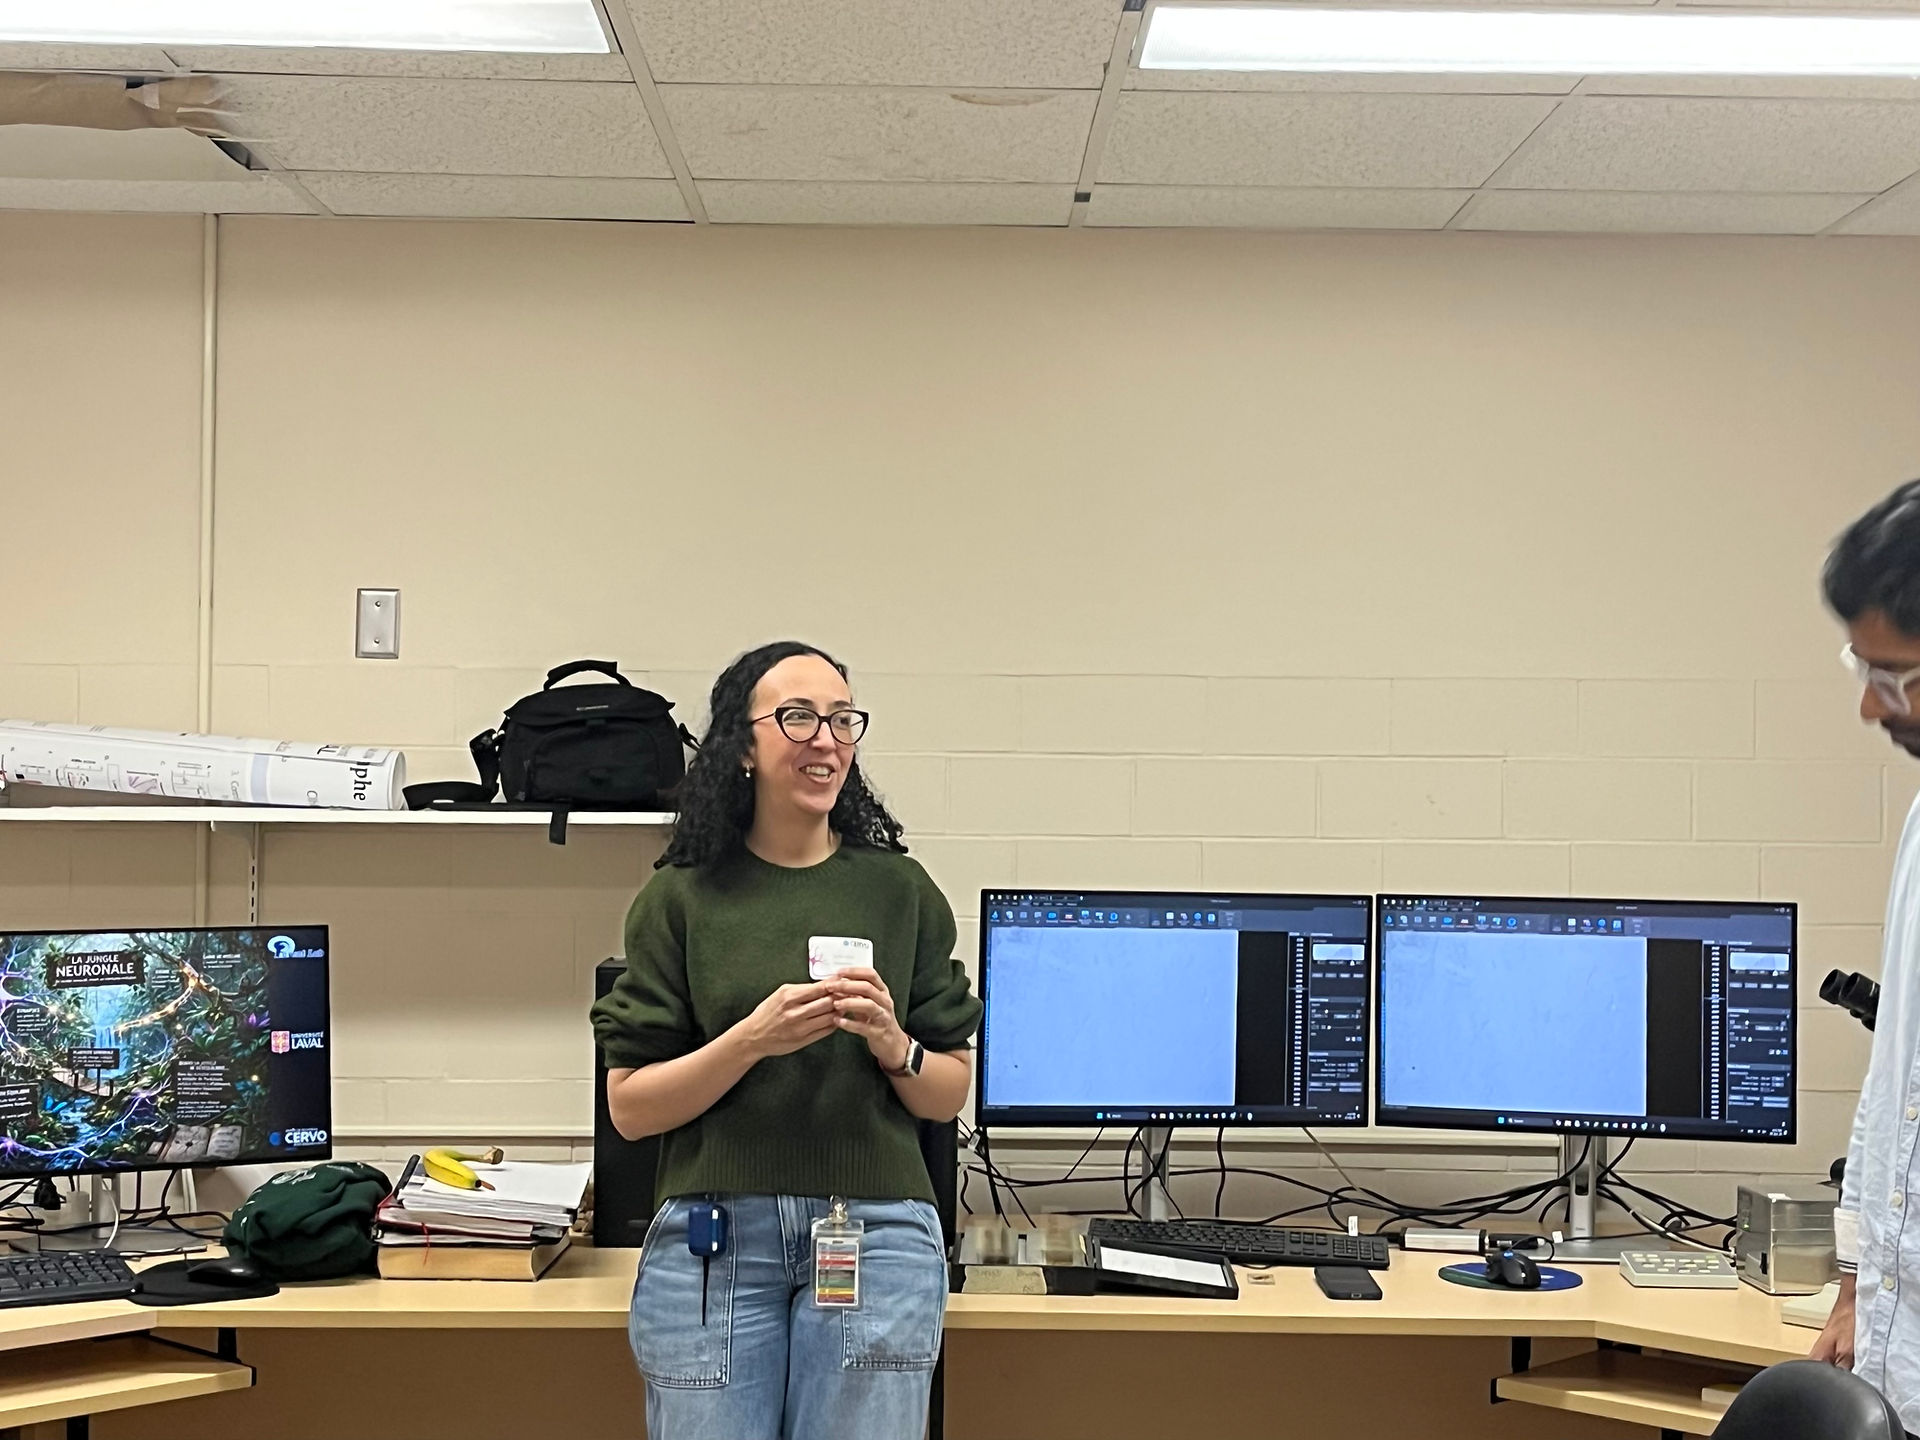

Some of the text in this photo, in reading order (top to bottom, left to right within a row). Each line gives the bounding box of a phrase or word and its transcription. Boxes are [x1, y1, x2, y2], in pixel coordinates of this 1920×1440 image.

[71, 954, 119, 965] LA JUNGLE
[56, 962, 135, 977] NEURONALE
[291, 1038, 324, 1049] LAVAL
[284, 1130, 328, 1144] CERVO
